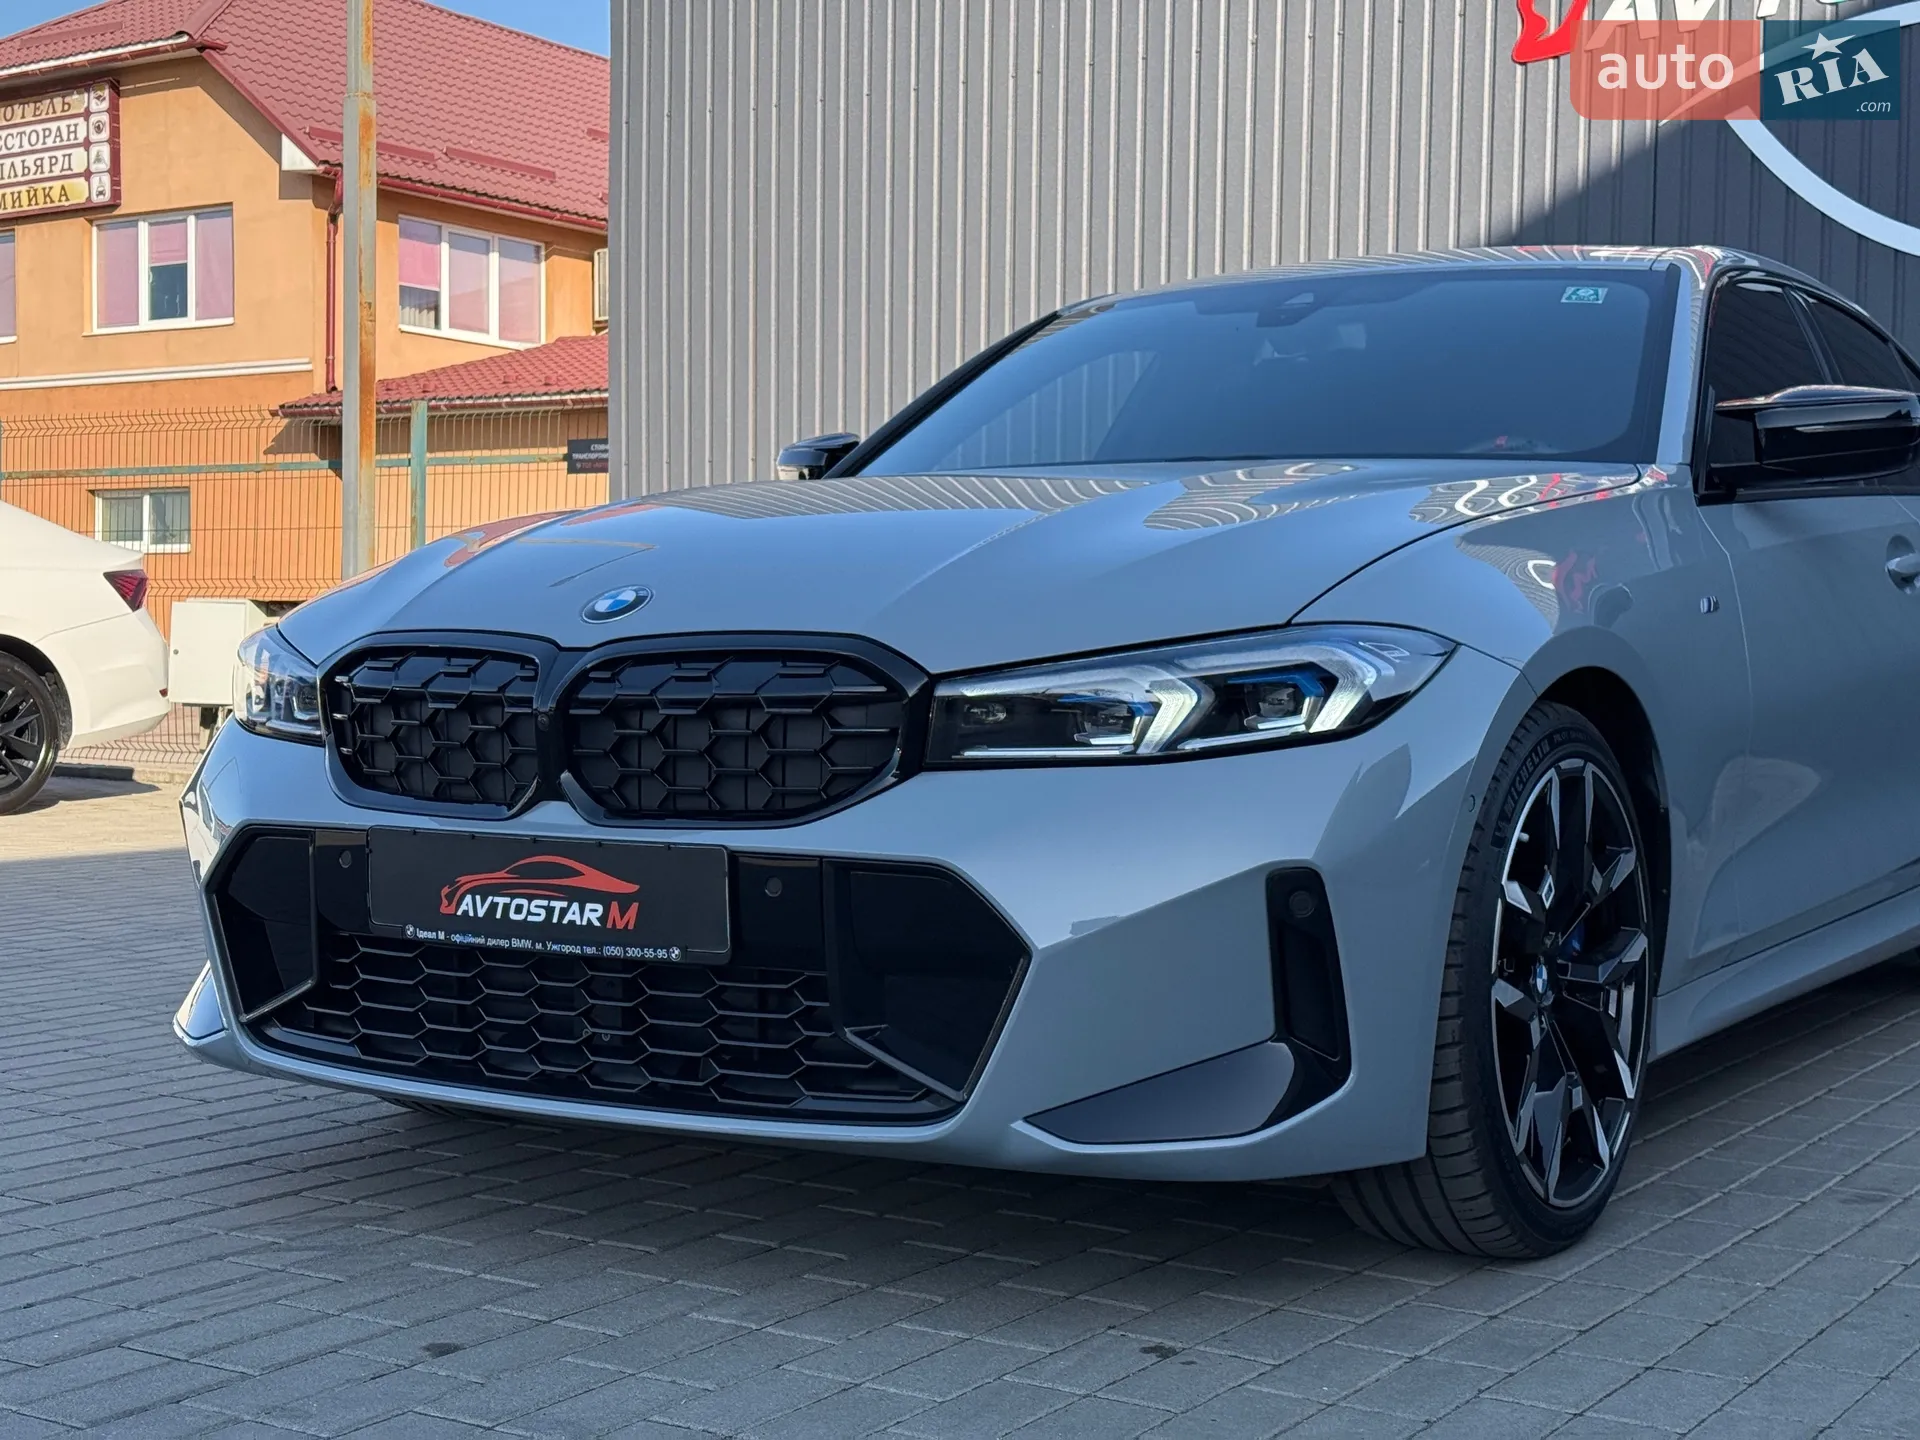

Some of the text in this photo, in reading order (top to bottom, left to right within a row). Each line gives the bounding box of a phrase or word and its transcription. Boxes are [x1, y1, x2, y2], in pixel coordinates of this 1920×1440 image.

[456, 894, 640, 930] AVTOSTAR M
[486, 937, 510, 948] дилер
[546, 941, 582, 953] Ужгород
[602, 945, 624, 958] (050)
[625, 947, 668, 959] 300-55-95
